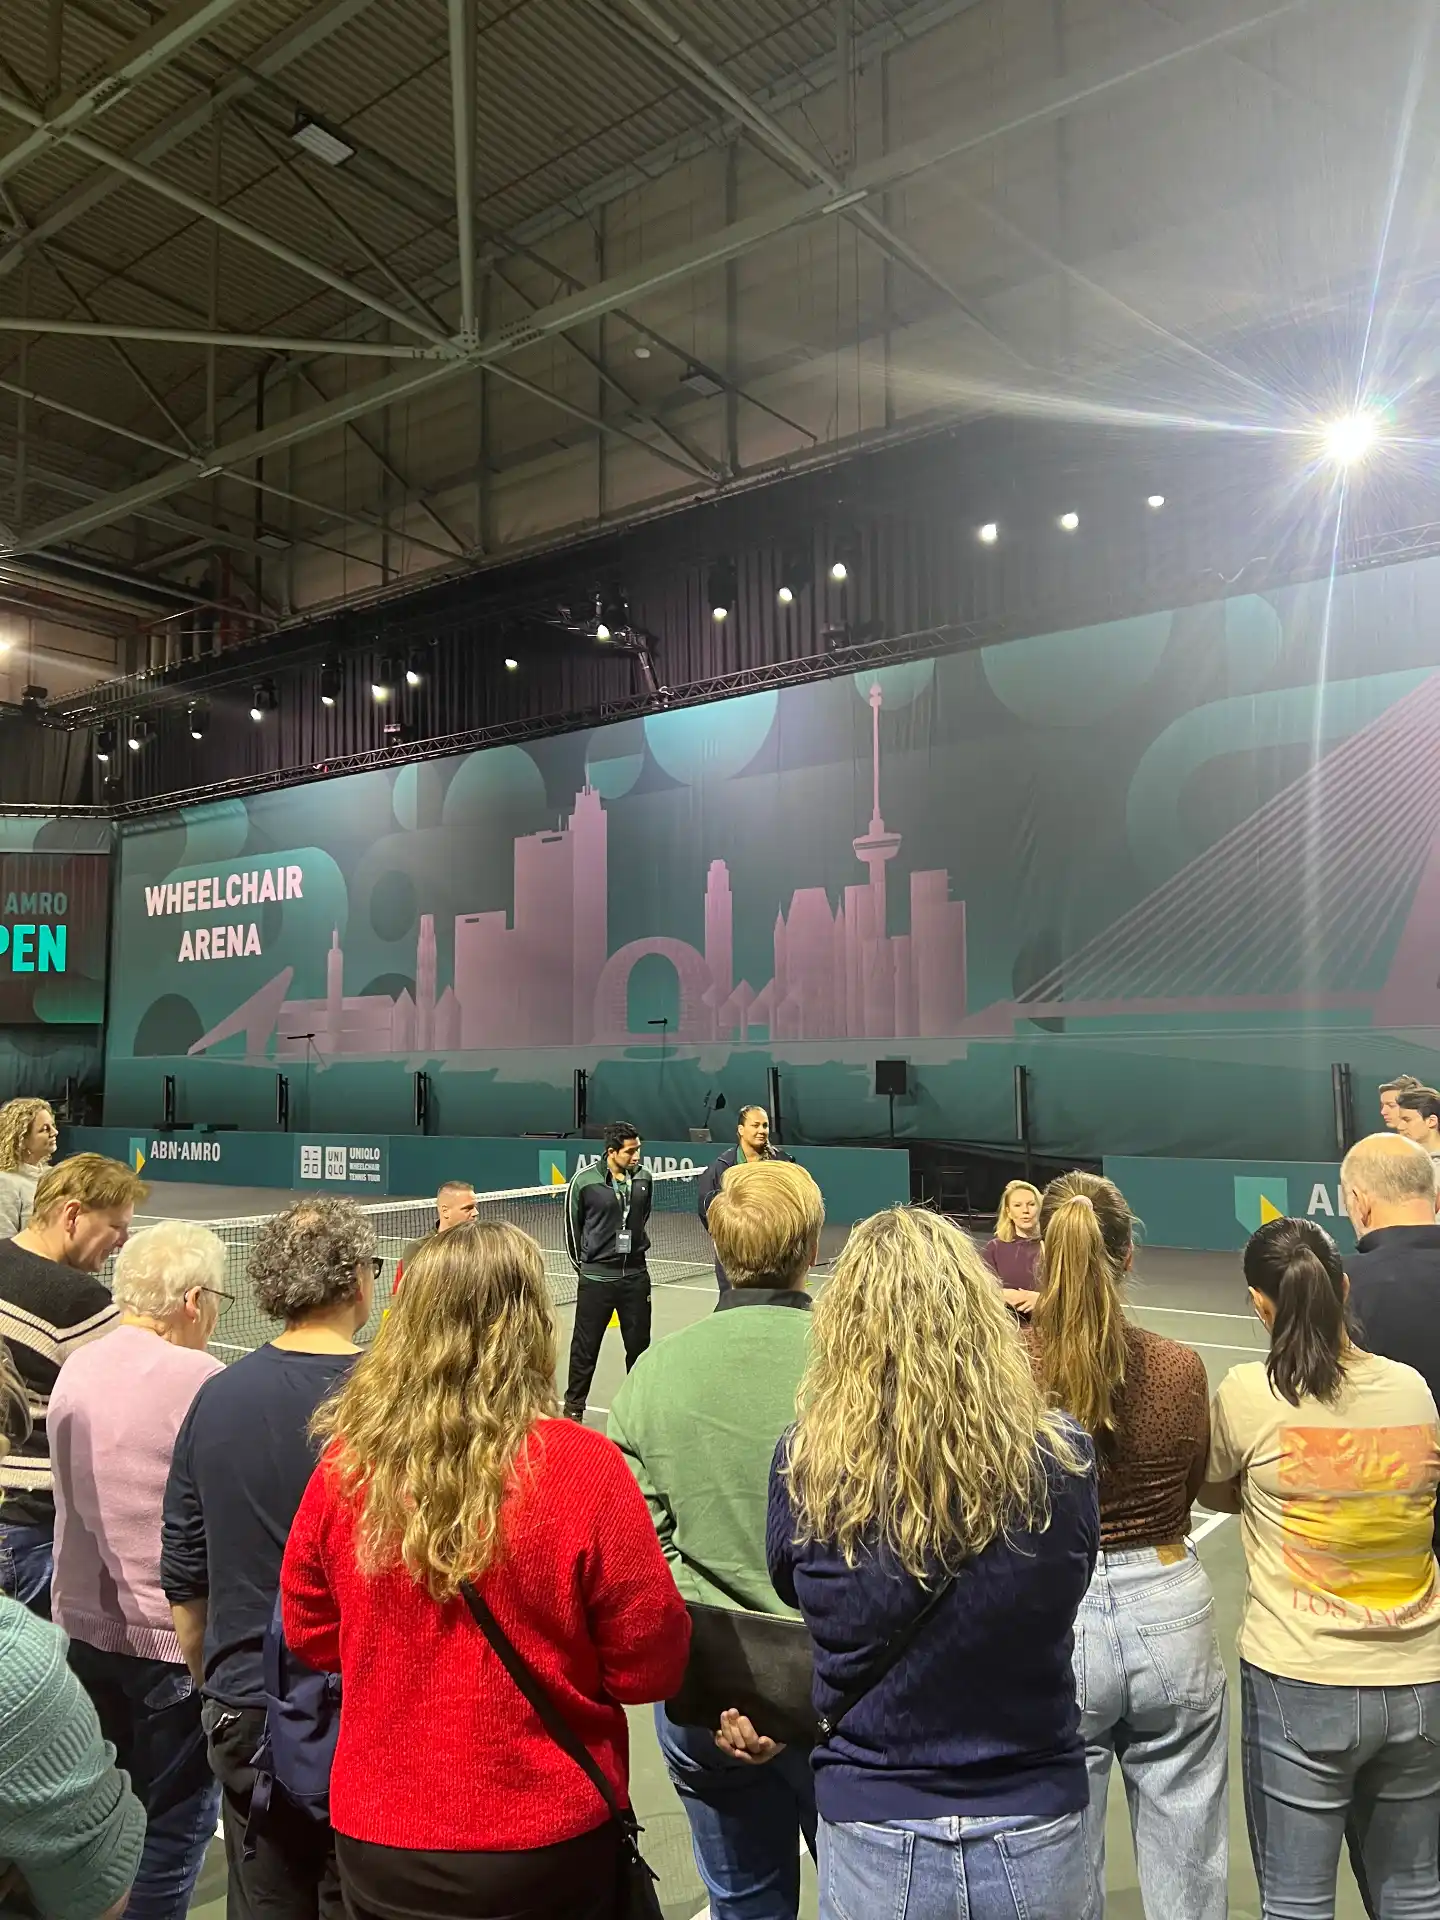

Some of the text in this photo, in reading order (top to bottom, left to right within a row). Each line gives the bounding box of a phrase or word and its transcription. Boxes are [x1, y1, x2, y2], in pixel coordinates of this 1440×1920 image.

[144, 865, 303, 917] WHEELCHAIR
[4, 891, 68, 916] AMRO
[178, 922, 262, 963] ARENA
[327, 1150, 343, 1162] UNI
[349, 1147, 381, 1161] UNIQLO
[327, 1164, 344, 1176] QLO
